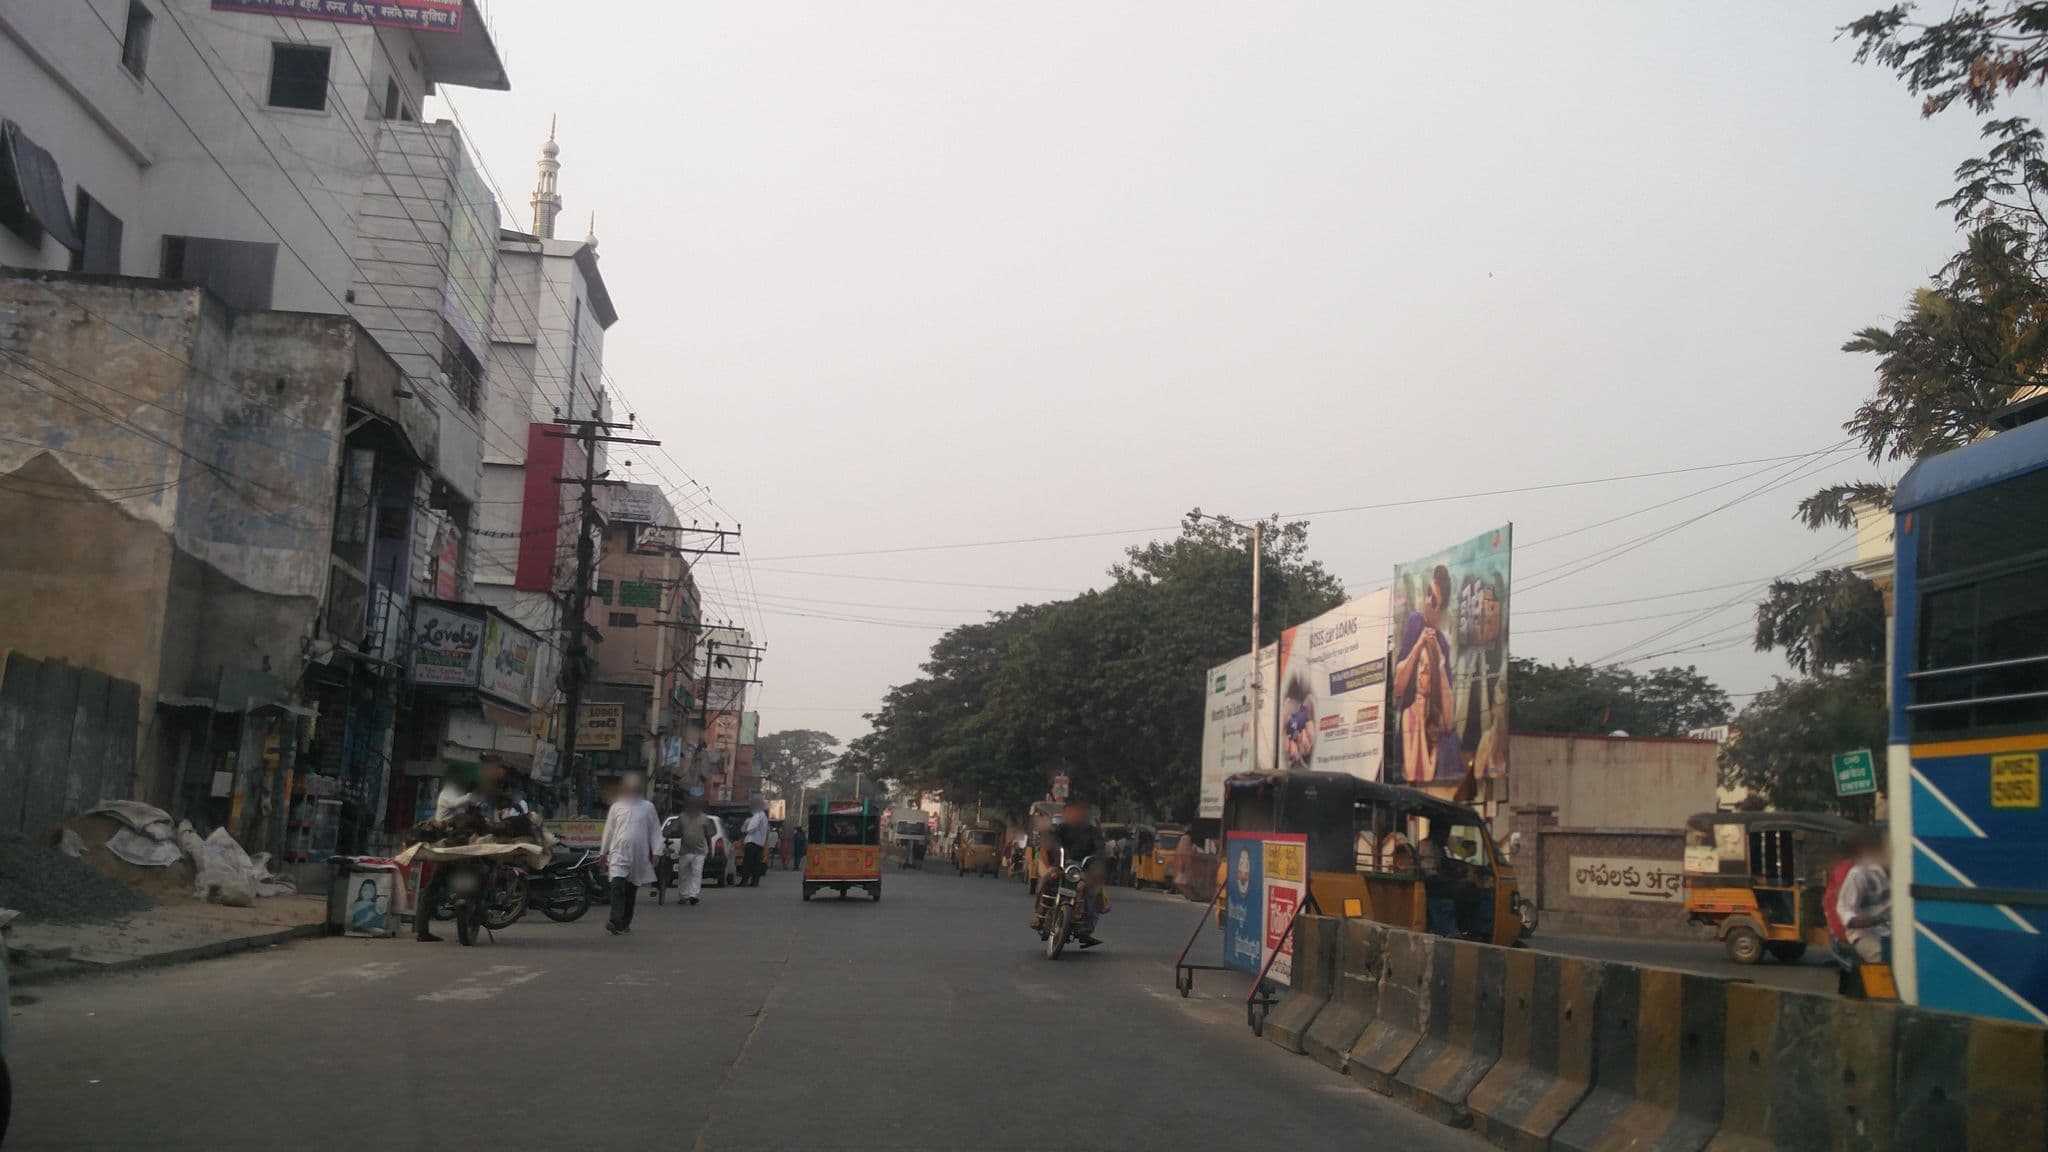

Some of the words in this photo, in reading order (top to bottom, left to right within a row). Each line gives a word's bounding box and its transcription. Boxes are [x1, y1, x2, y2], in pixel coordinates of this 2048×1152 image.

[421, 9, 447, 26] सुविधा
[450, 11, 457, 26] है
[417, 618, 479, 649] Lovely
[590, 707, 619, 717] LODGE
[1646, 868, 1687, 893] अंद
